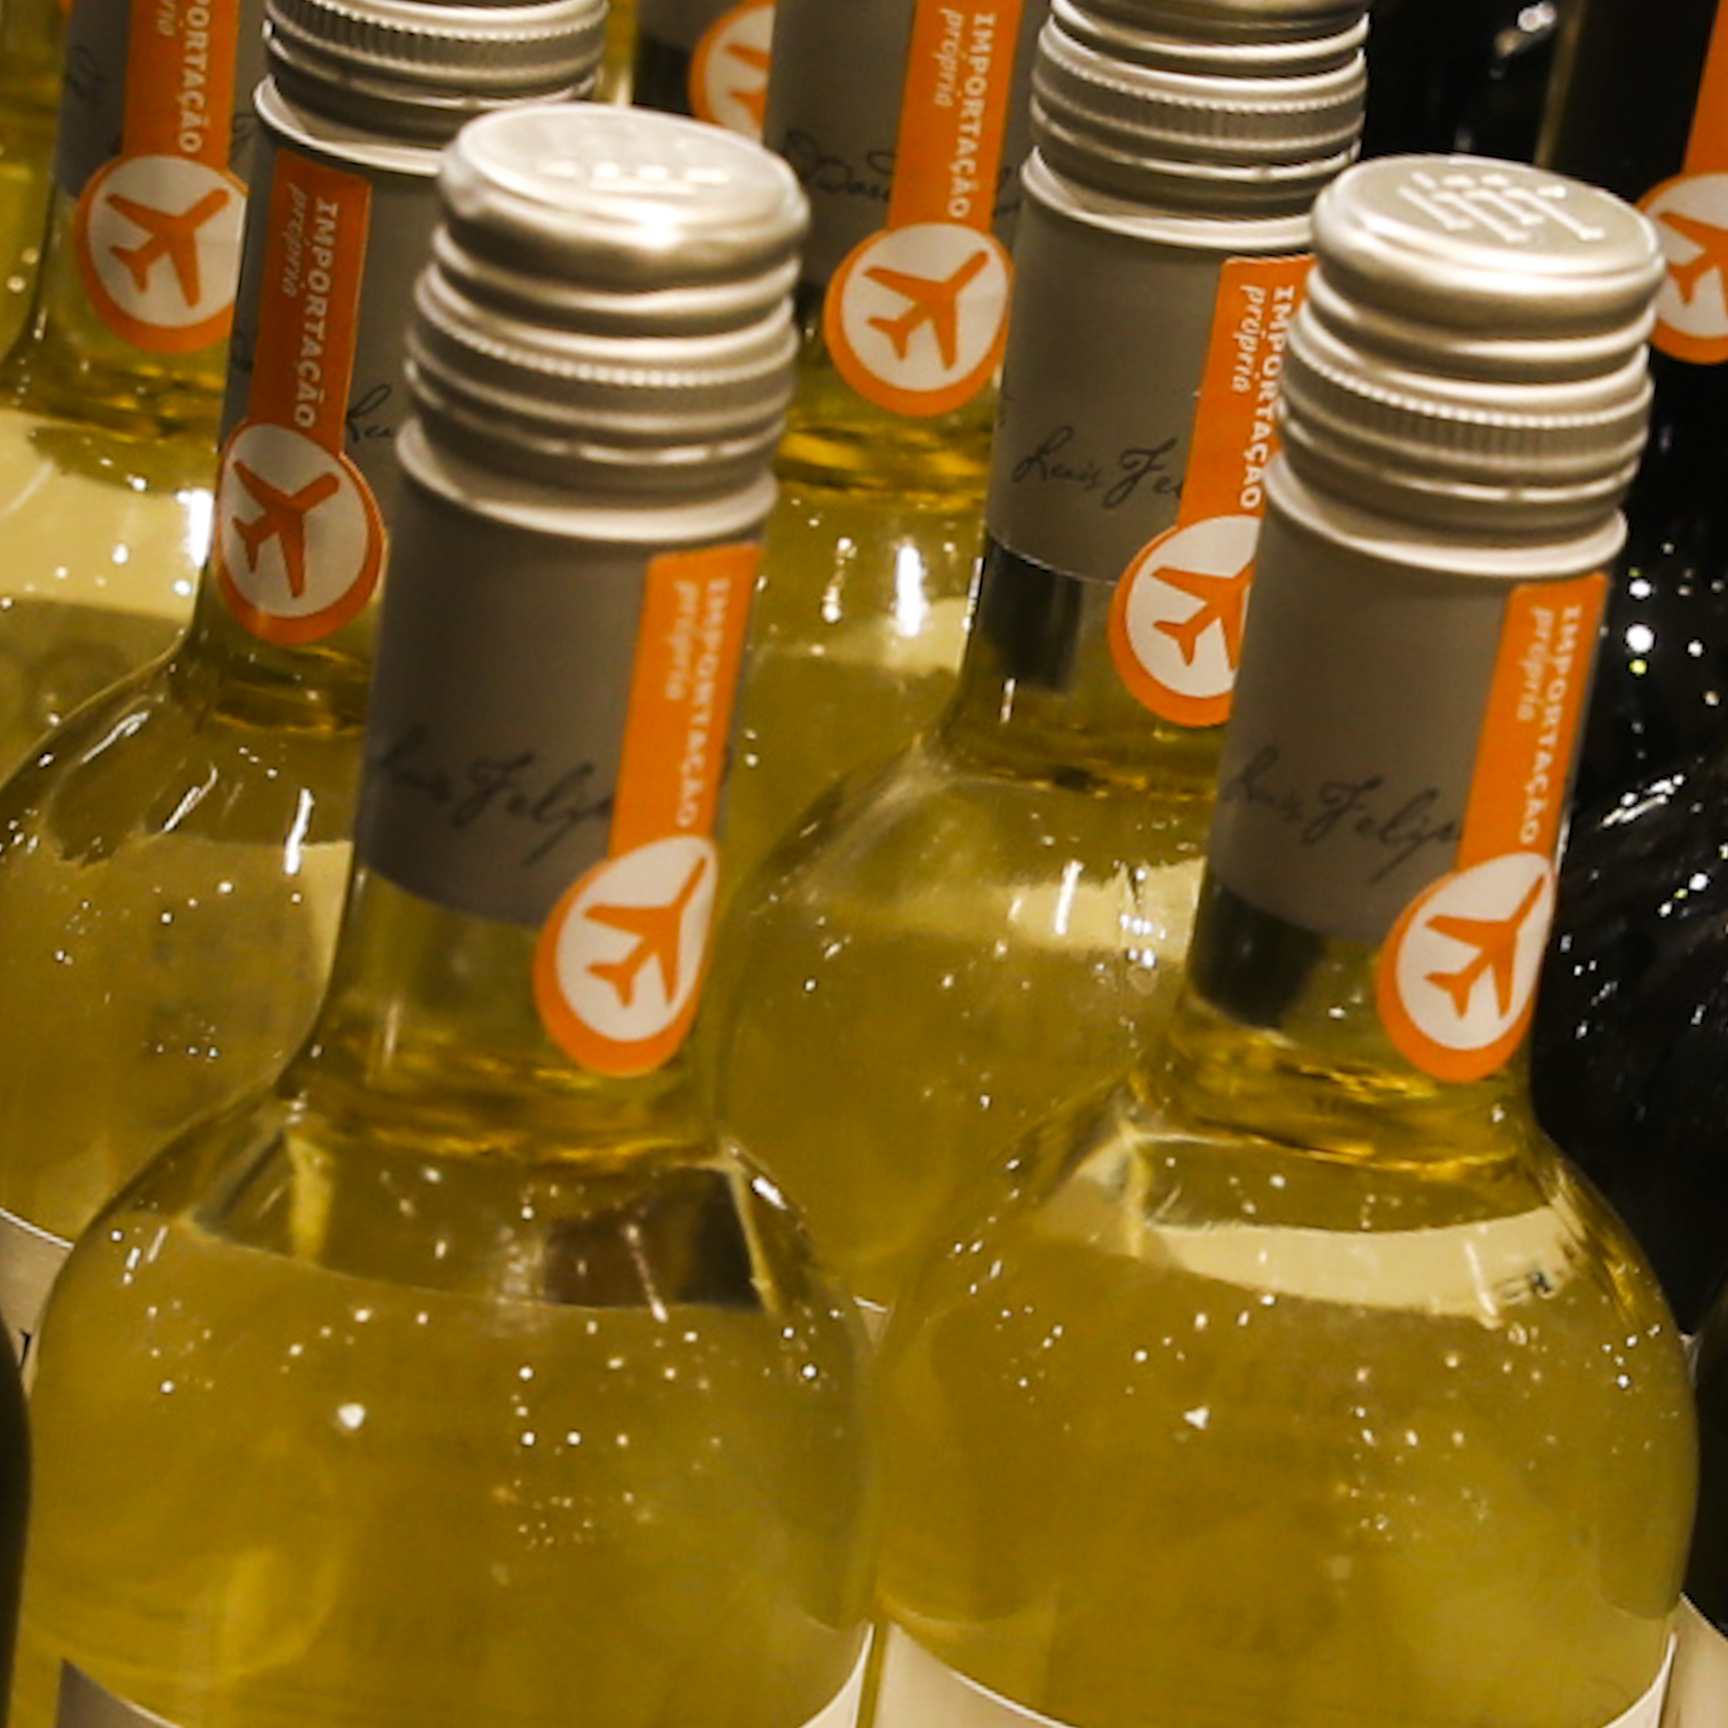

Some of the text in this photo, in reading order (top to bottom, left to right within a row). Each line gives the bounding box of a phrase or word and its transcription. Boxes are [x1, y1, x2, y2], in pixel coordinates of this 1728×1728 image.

[933, 8, 967, 108] própria
[948, 12, 995, 218] IMPORTAÇÃO
[295, 197, 338, 427] IMPORTAÇÃO
[1232, 284, 1266, 392] própria
[675, 577, 731, 827] IMPORTAÇÃO
[1516, 605, 1555, 721] própria
[1519, 605, 1582, 844] IMPORTAÇÃO
